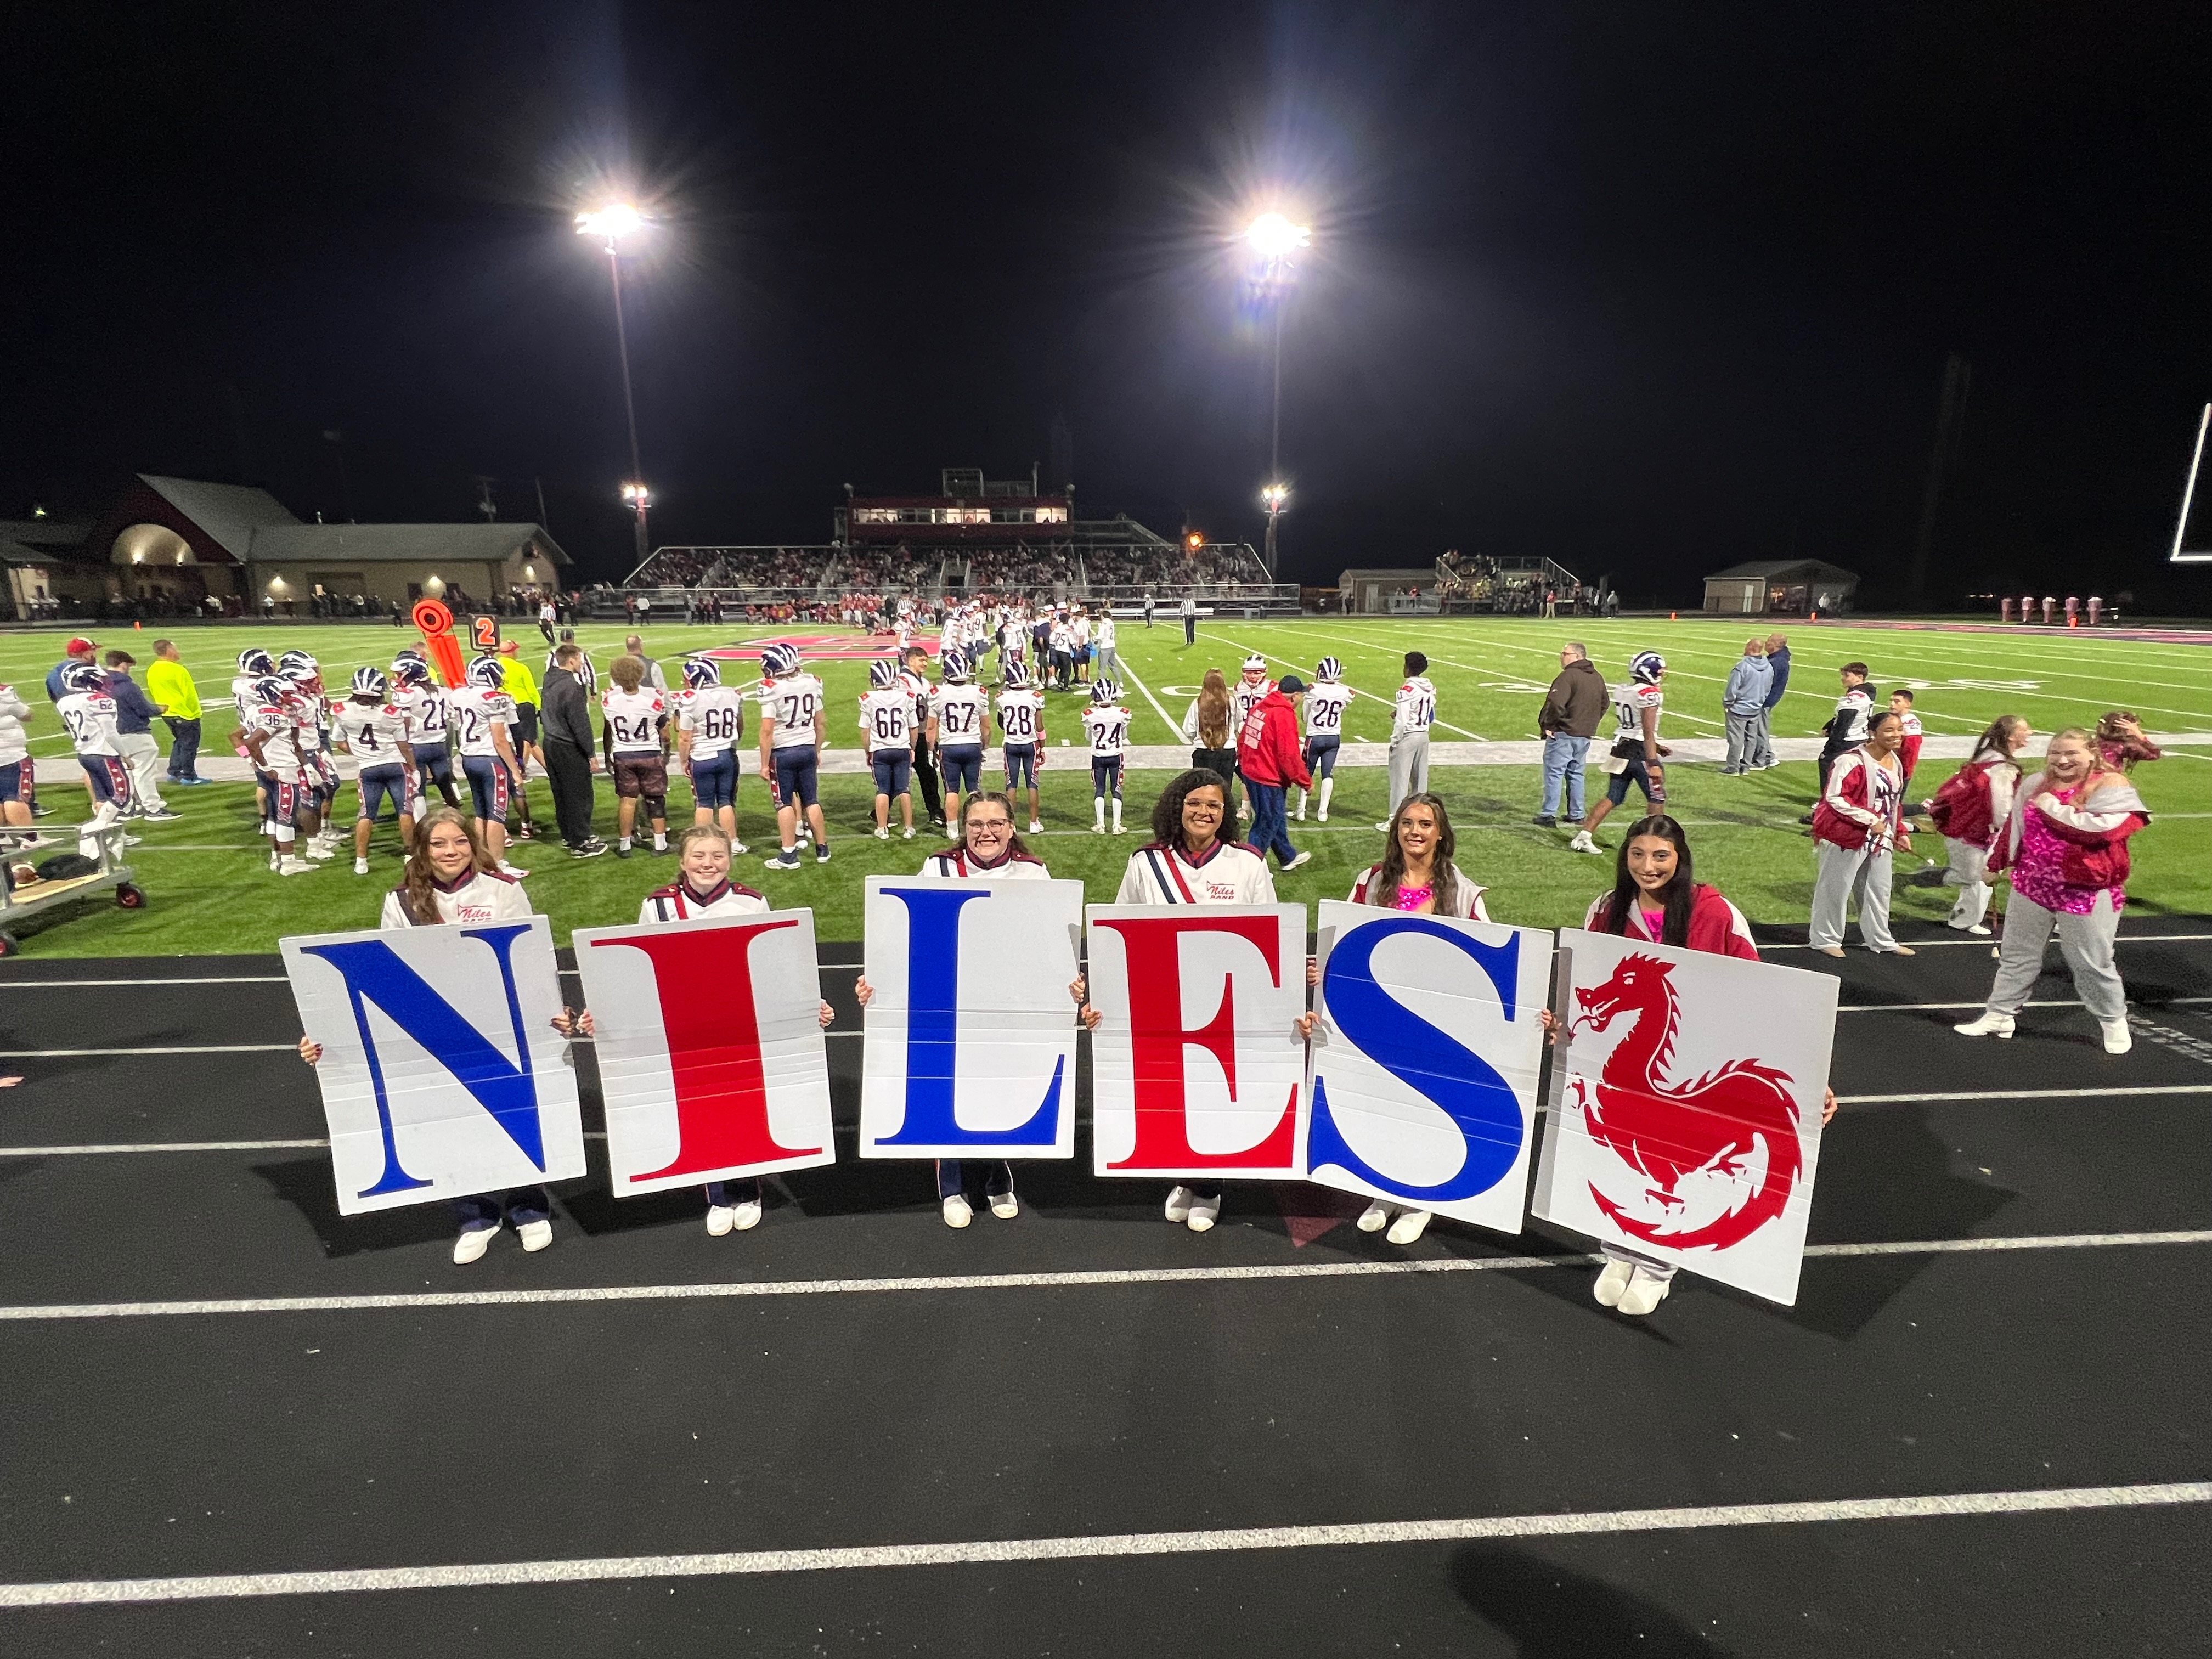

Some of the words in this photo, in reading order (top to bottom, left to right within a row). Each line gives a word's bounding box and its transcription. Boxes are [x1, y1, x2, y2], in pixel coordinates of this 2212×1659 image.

[476, 617, 496, 645] 2
[99, 699, 114, 710] 62
[421, 698, 447, 731] 21
[784, 693, 814, 729] 79
[945, 702, 975, 733] 67
[1313, 699, 1342, 727] 26
[1415, 696, 1431, 726] 11
[264, 714, 280, 726] 36
[613, 716, 650, 742] 64
[706, 708, 737, 739] 68
[876, 708, 902, 738] 66
[1004, 705, 1031, 735] 28
[358, 723, 380, 752] 4
[1093, 721, 1122, 751] 24
[1207, 885, 1234, 895] Niles
